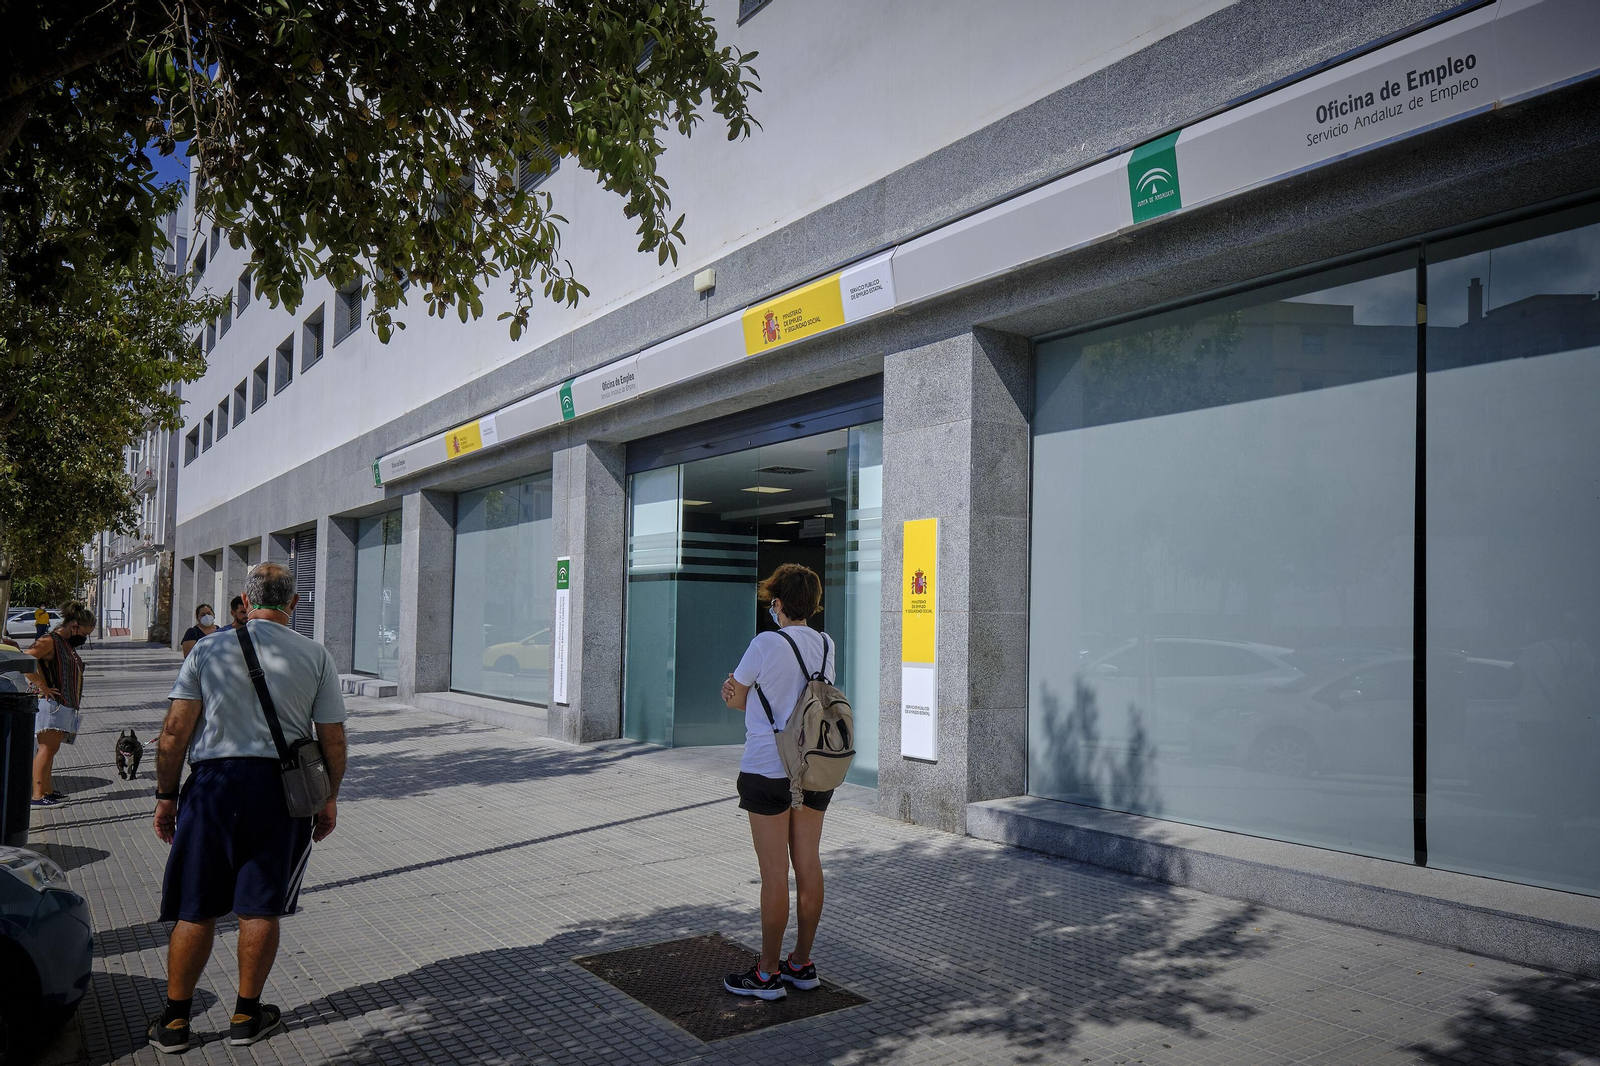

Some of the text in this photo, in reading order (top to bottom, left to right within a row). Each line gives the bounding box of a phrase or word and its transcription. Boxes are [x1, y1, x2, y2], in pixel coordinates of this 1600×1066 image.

[1315, 53, 1477, 124] Oficina de Empleo
[1307, 75, 1480, 147] Servicio Andaluz de Empleo
[1137, 198, 1149, 208] JUNTA
[850, 284, 865, 294] SERVICIO
[856, 289, 869, 298] EMPLEO
[782, 308, 802, 320] MINISTERIO
[788, 315, 802, 325] EMPLEO
[788, 320, 808, 333] SEGURIDAD
[808, 316, 822, 326] SOCIAL
[602, 372, 635, 391] Oficina de Empleo
